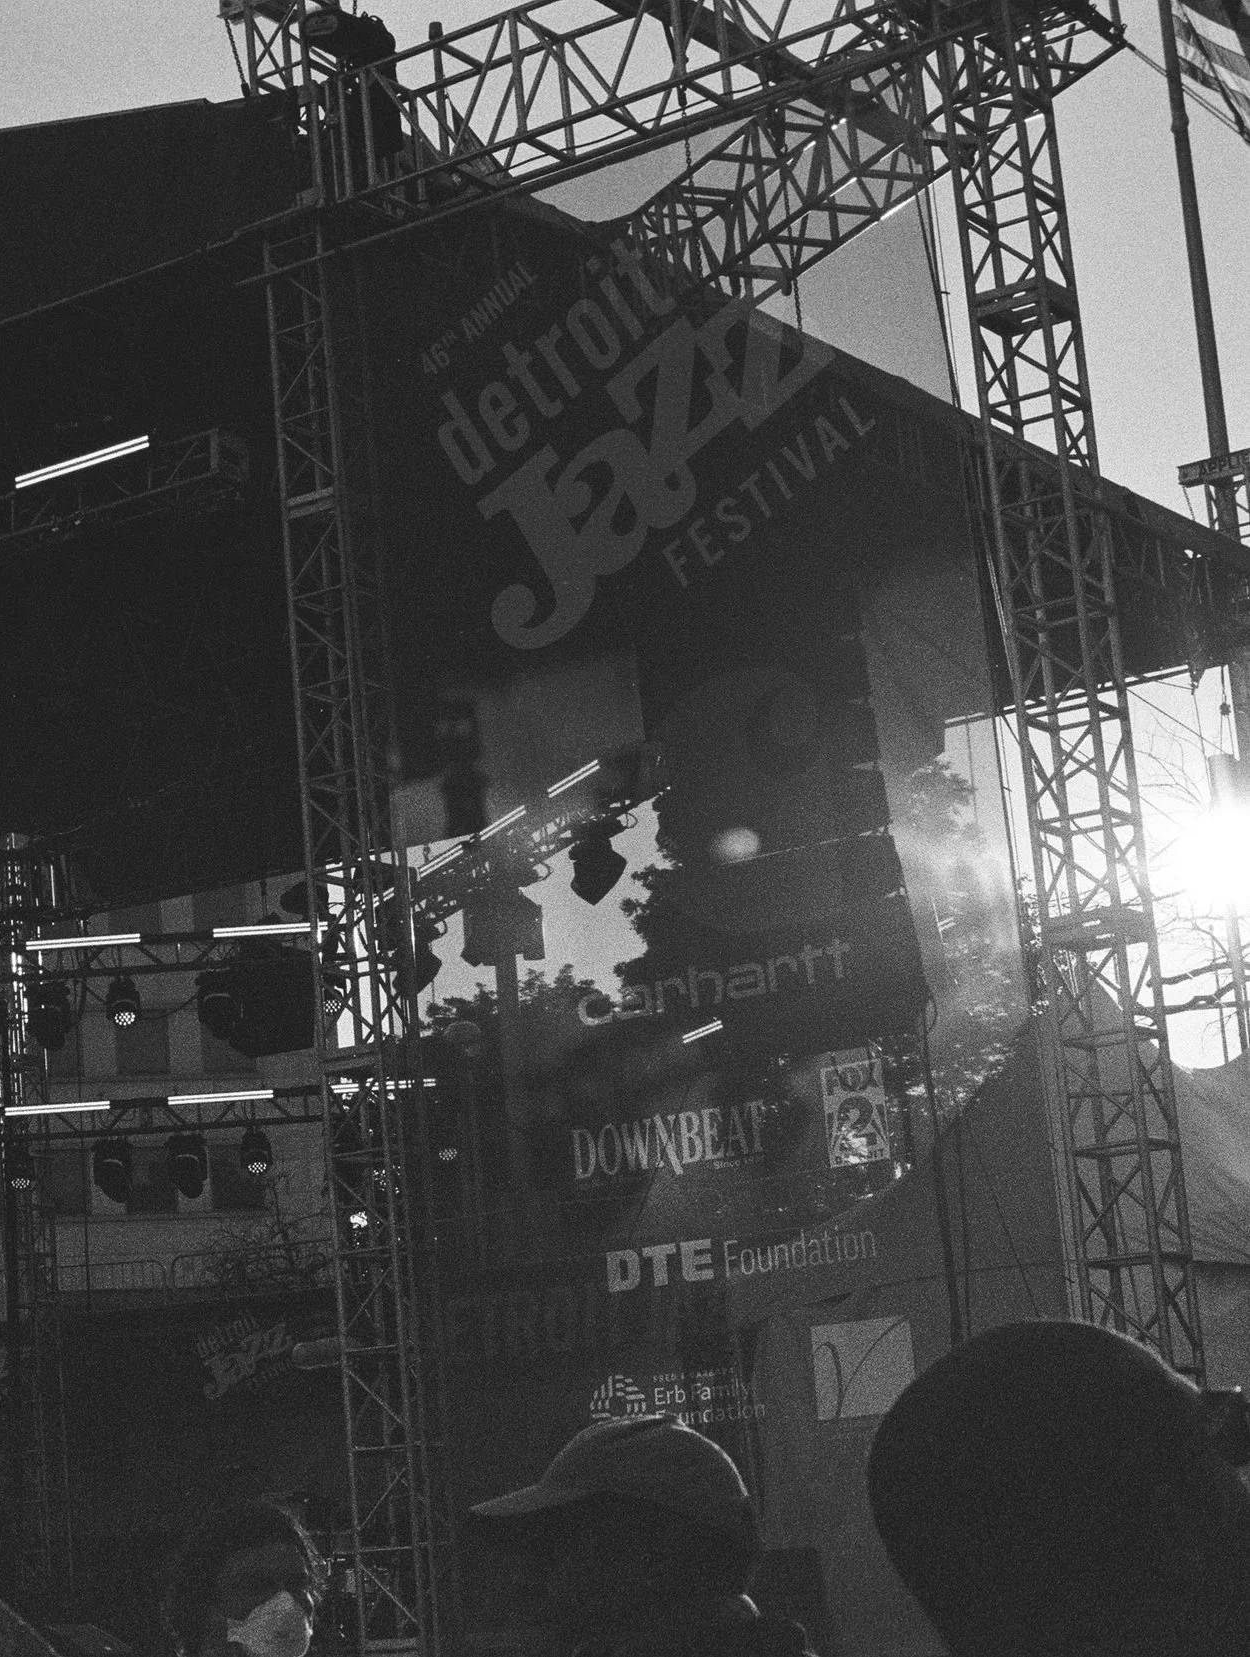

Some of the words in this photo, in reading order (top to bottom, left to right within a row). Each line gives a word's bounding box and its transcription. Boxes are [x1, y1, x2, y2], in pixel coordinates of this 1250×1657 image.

[460, 261, 539, 343] ANNUAL
[437, 238, 677, 486] detroit
[662, 395, 877, 588] FESTIVAL
[577, 937, 851, 1027] carhartt
[571, 1099, 766, 1181] DOWNBEAT
[606, 1238, 716, 1294] DTE
[722, 1228, 878, 1280] Foundation
[653, 1384, 686, 1405] Erb
